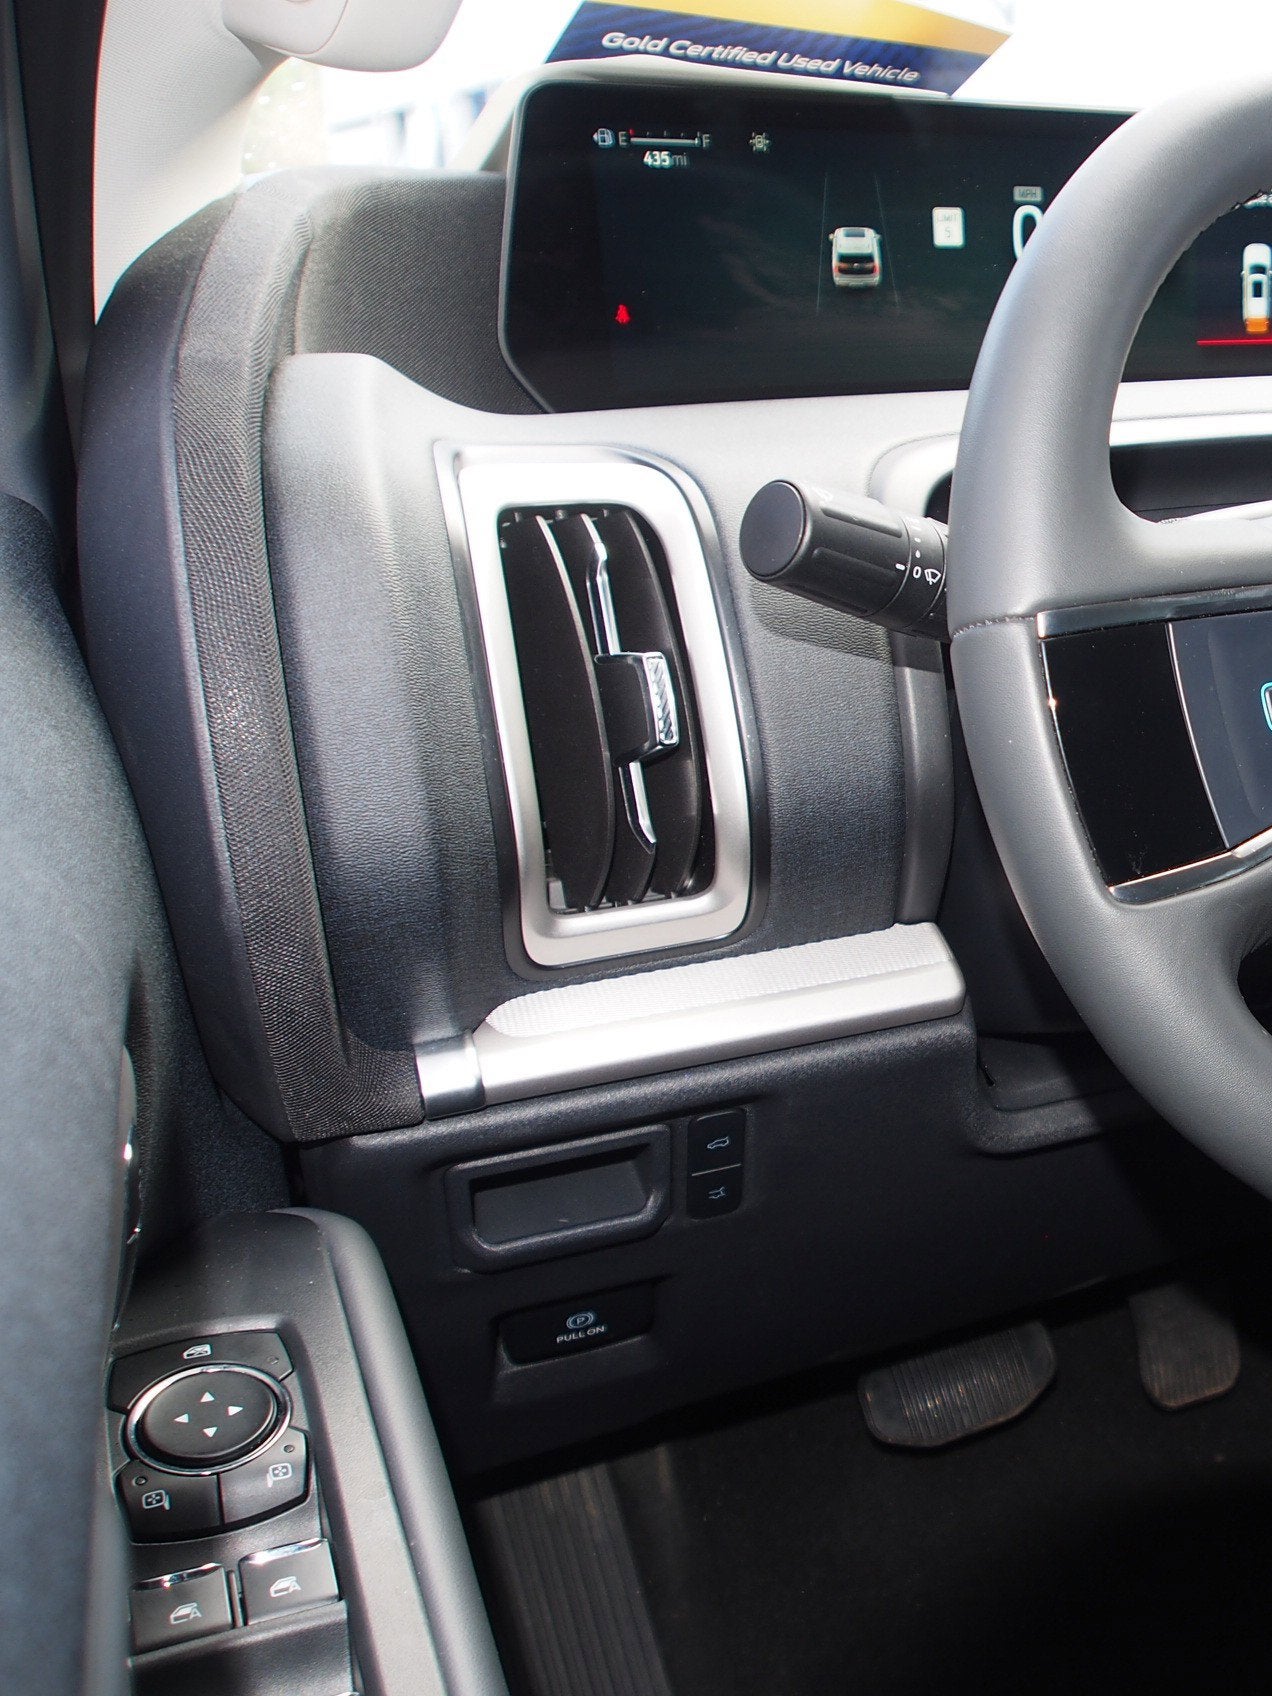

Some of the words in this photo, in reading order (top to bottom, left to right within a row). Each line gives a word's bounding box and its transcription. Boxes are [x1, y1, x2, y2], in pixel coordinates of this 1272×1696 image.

[602, 32, 669, 52] Gold
[669, 40, 778, 66] Certified
[777, 52, 842, 74] Used
[842, 60, 921, 82] Vehicle
[619, 131, 627, 145] E
[702, 134, 710, 147] F
[1018, 189, 1037, 198] MPH
[556, 1331, 585, 1343] PULL
[587, 1325, 605, 1335] ON
